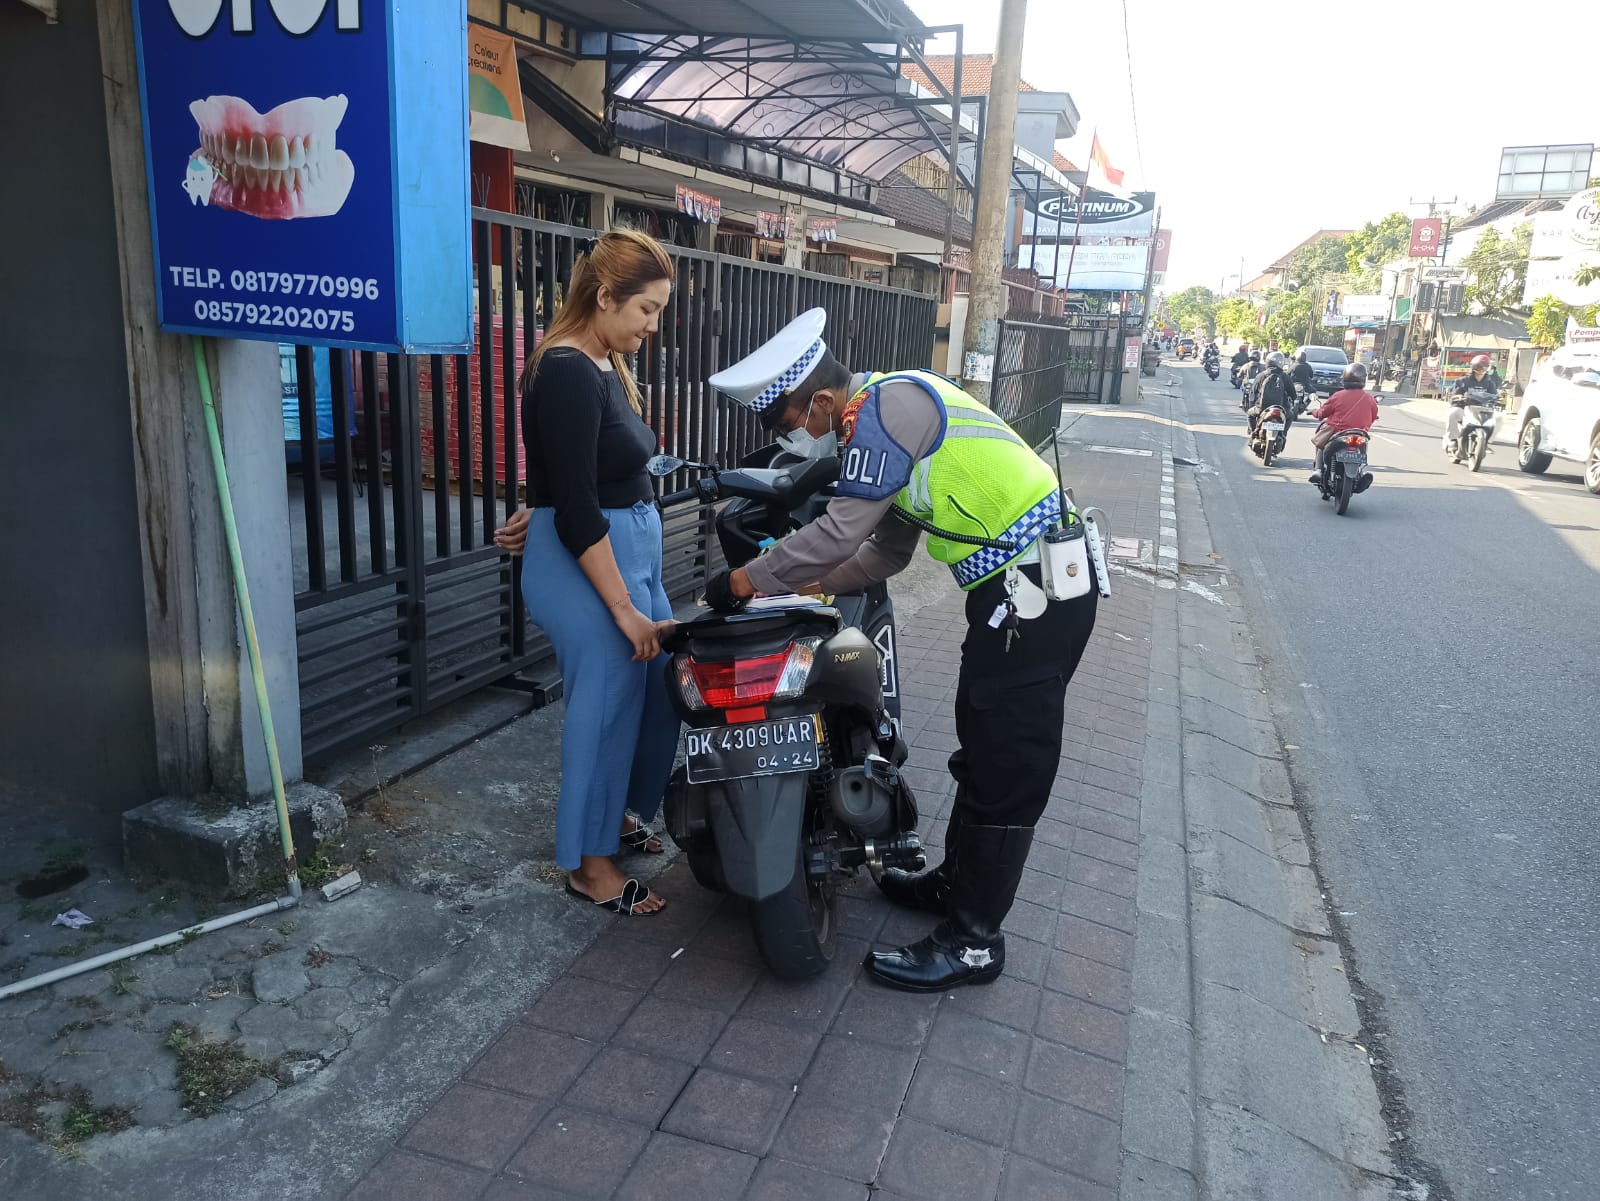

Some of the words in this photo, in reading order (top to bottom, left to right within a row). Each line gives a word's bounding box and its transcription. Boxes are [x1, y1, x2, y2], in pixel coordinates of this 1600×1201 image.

[169, 265, 225, 290] TELP.
[230, 270, 379, 301] 08179770996
[194, 299, 355, 333] 085792202075
[839, 447, 887, 487] OLI
[687, 732, 713, 756] DK
[721, 725, 769, 750] 4309
[774, 721, 811, 745] UAR
